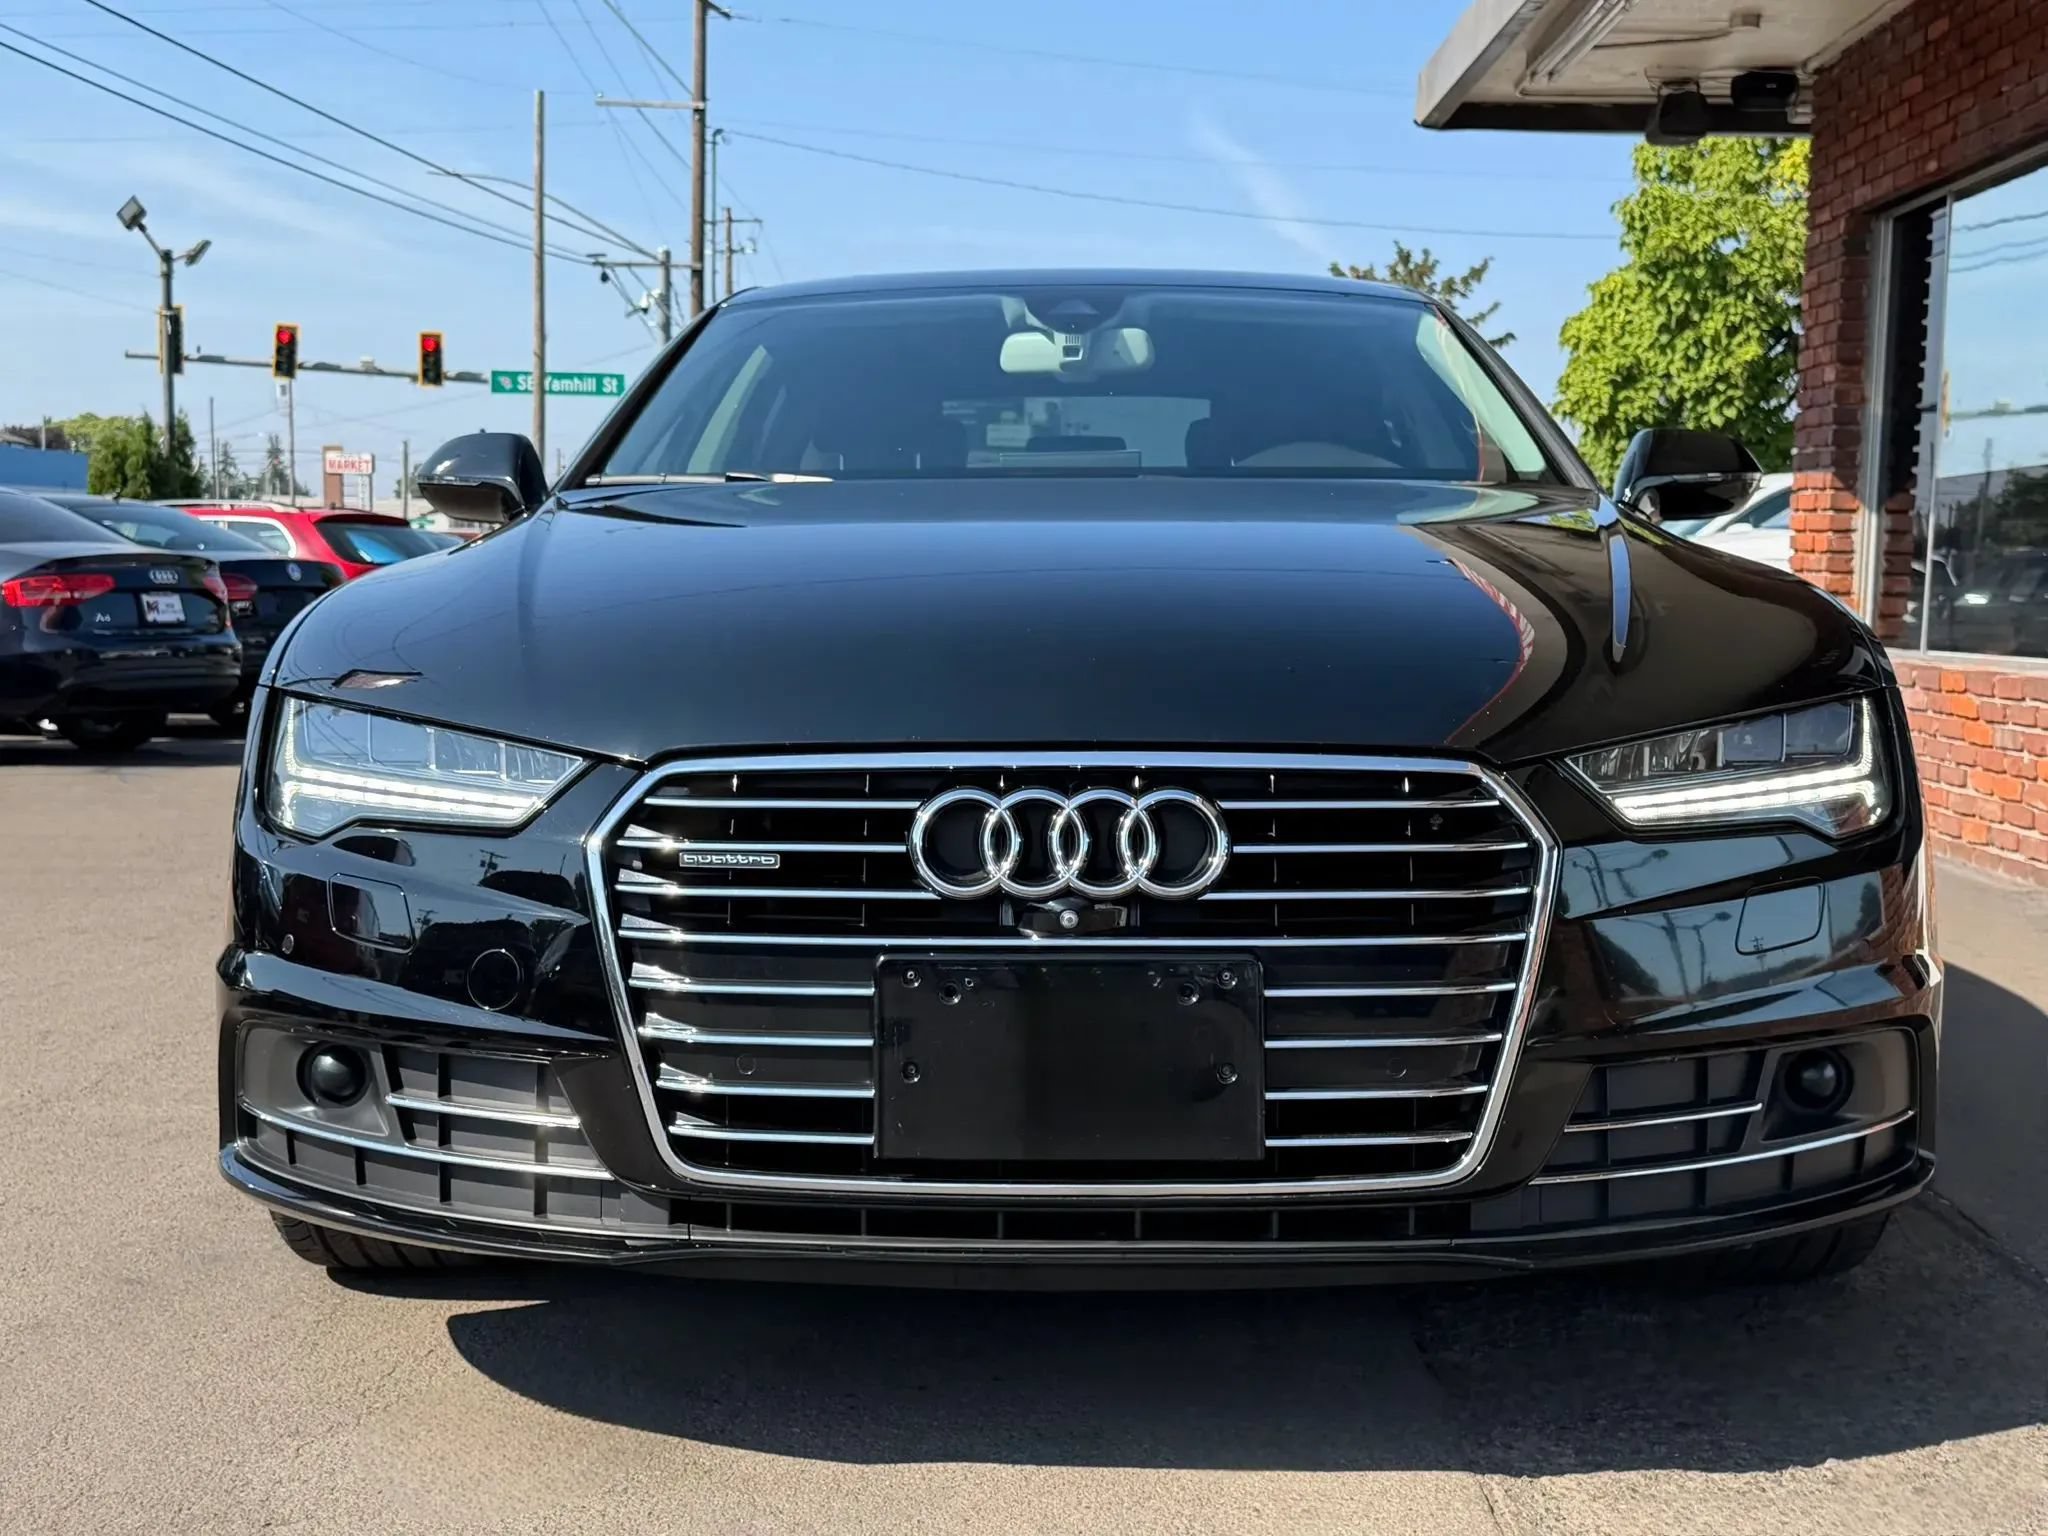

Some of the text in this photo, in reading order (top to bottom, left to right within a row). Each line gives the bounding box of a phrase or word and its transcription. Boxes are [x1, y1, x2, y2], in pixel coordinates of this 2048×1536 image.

[544, 375, 596, 393] Yamhill
[602, 377, 618, 393] St
[328, 459, 370, 472] MARKET
[683, 854, 775, 864] quattro
